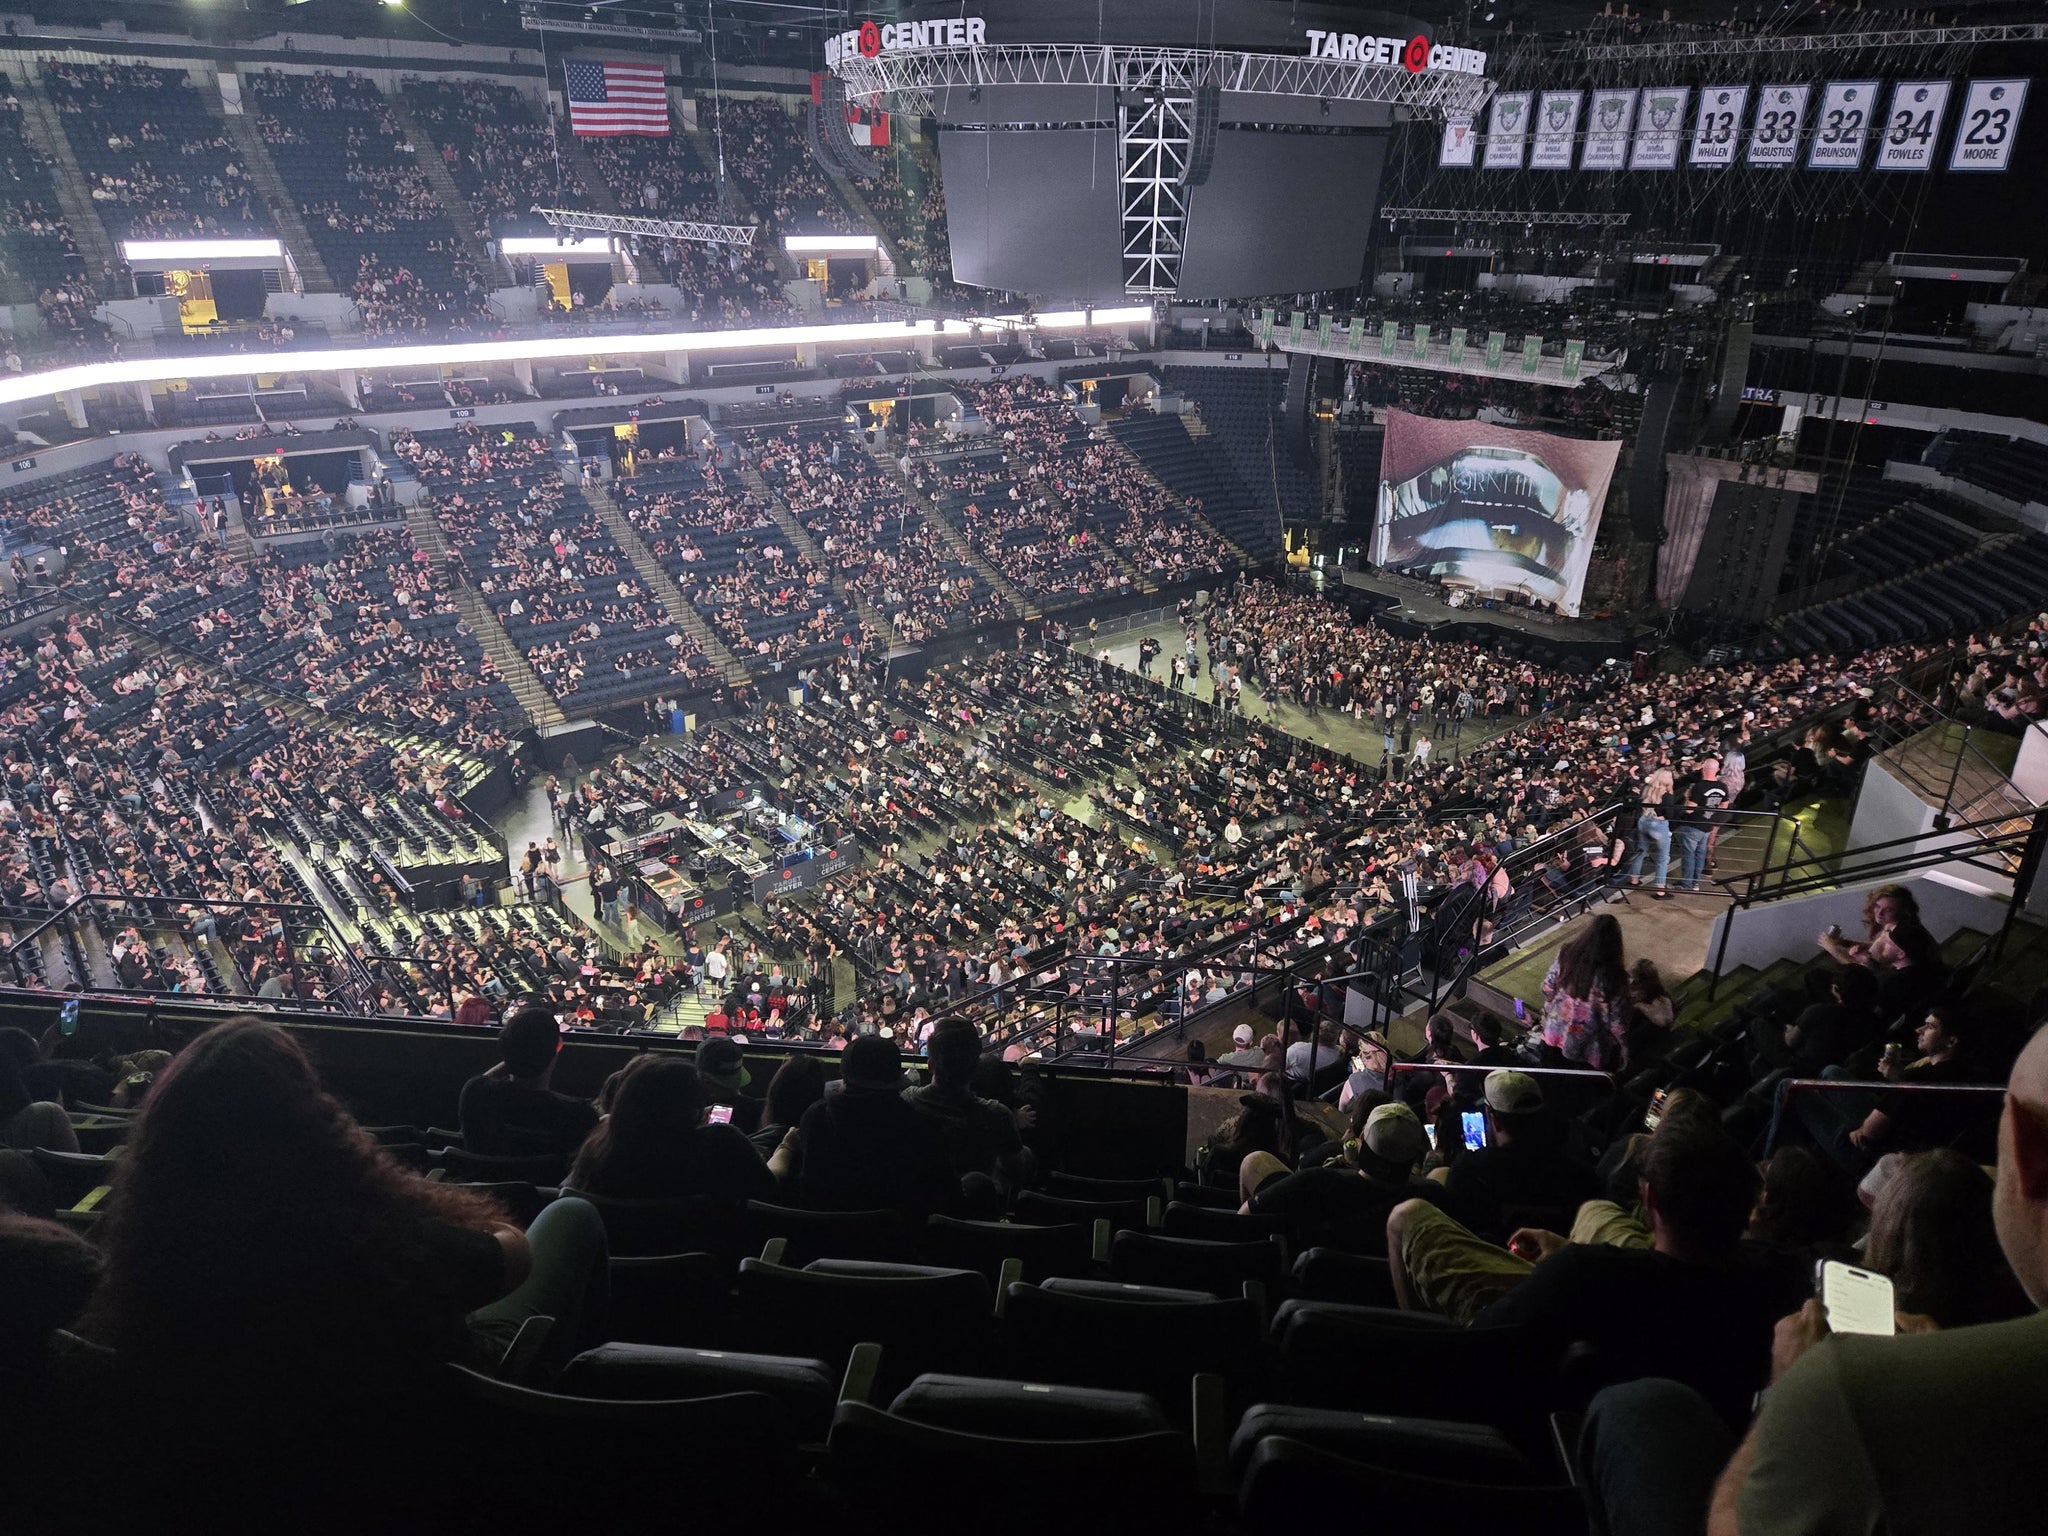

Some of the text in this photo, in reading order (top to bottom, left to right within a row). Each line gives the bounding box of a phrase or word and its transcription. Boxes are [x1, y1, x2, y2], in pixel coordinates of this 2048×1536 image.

[881, 17, 986, 50] CENTER
[1306, 29, 1487, 75] TARGET CENTER
[1700, 111, 1734, 144] 13
[1758, 110, 1797, 144] 33
[1822, 109, 1863, 144] 32
[1889, 109, 1935, 145] 34
[1964, 109, 2011, 145] 23
[1698, 147, 1729, 157] WHALEN
[1752, 147, 1794, 157] AUGUSTUS
[1815, 147, 1858, 158] BRUNSON
[1887, 148, 1925, 160] FOWLES
[1963, 148, 2001, 160] MOORE
[18, 459, 31, 469] 106
[821, 855, 846, 869] TARGET
[821, 861, 847, 876] CENTER
[773, 875, 802, 889] TARGET
[773, 881, 803, 895] CENTER
[688, 909, 716, 924] ENTER
